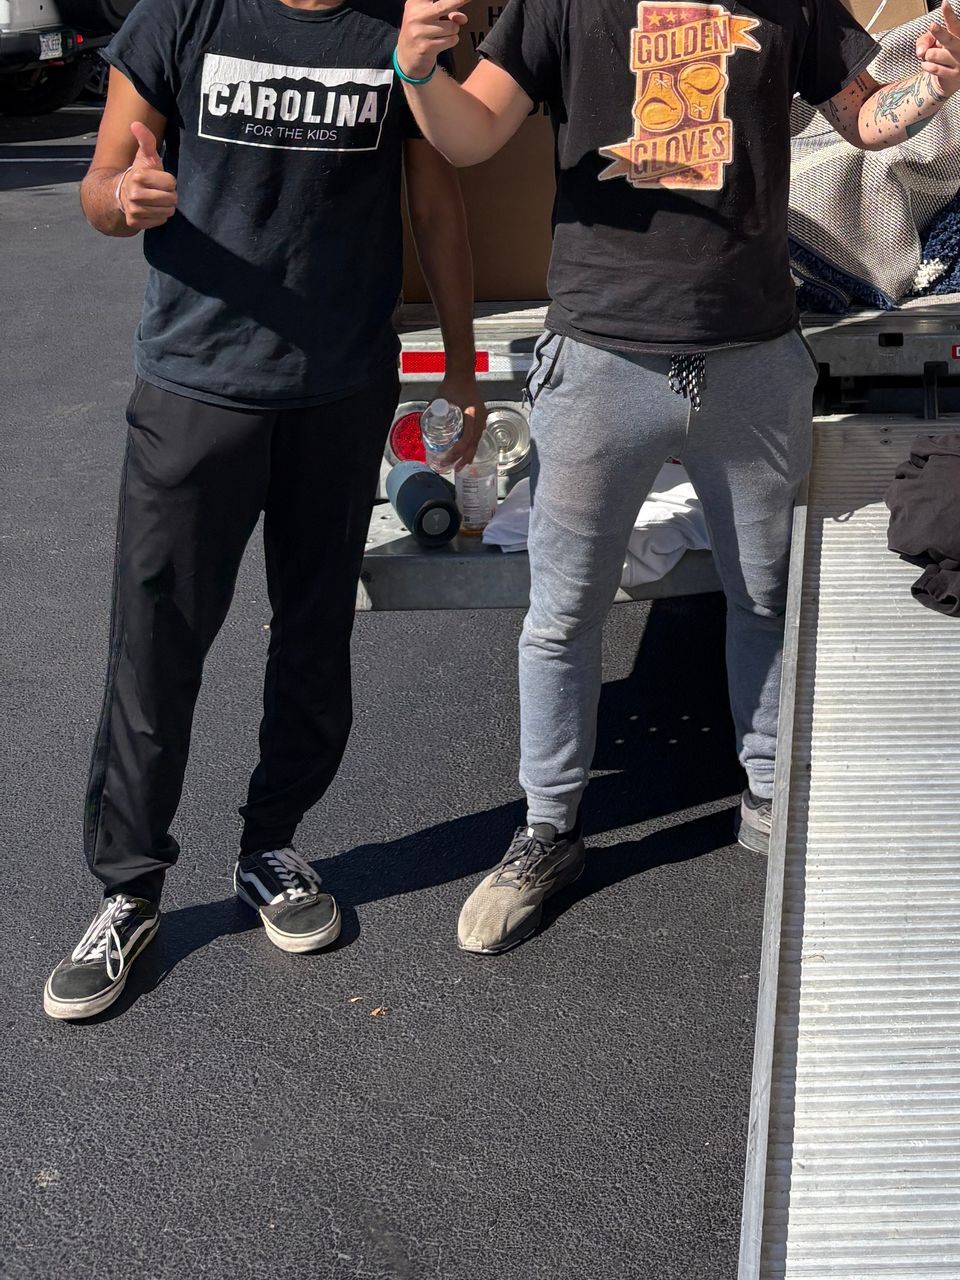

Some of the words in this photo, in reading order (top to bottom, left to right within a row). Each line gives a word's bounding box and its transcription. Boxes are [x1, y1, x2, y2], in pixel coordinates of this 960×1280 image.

[637, 18, 729, 65] GOLDEN
[207, 82, 378, 127] CAROLINA
[245, 123, 274, 137] FOR
[276, 126, 303, 140] THE
[306, 129, 338, 141] KIDS
[633, 126, 726, 175] GLOVES
